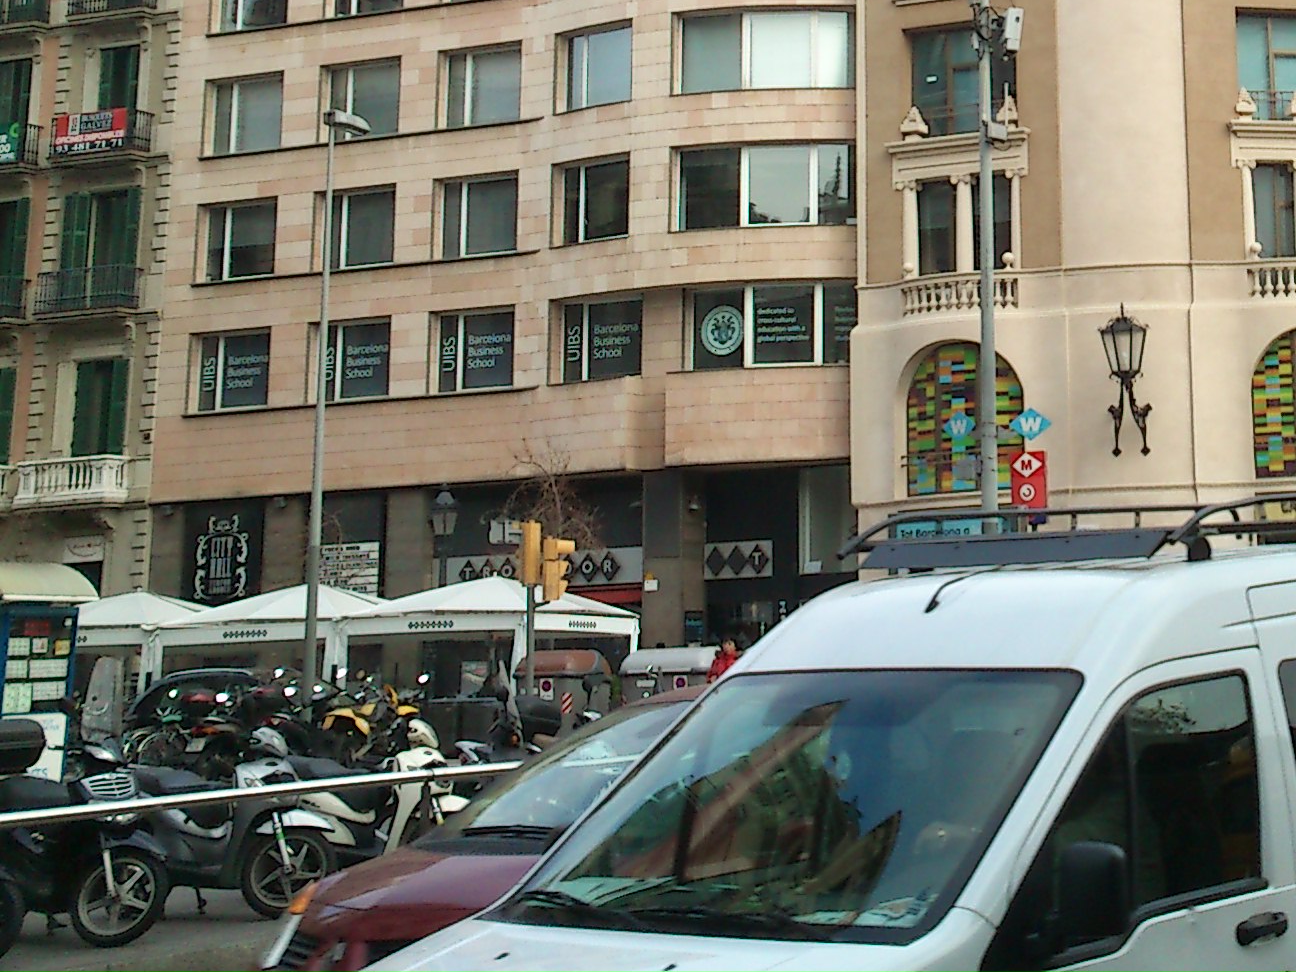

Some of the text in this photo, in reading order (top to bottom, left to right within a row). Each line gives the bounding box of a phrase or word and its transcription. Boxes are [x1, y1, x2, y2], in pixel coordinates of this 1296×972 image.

[594, 323, 639, 334] Barcelona
[468, 331, 511, 344] Barcelona
[593, 335, 631, 347] Business
[346, 343, 388, 356] Barcelona
[567, 326, 580, 362] UIBS
[443, 336, 456, 372] UIBS
[467, 345, 504, 357] Business
[593, 347, 622, 360] School
[228, 354, 268, 366] Barcelona
[325, 347, 335, 381] UIBS
[346, 356, 381, 368] Business
[467, 358, 495, 369] School
[203, 357, 216, 392] UIBS
[227, 367, 262, 378] Business
[345, 368, 373, 379] School
[226, 378, 253, 389] School
[951, 419, 967, 435] W
[1020, 417, 1042, 432] W
[1020, 459, 1033, 471] M
[752, 551, 763, 566] T
